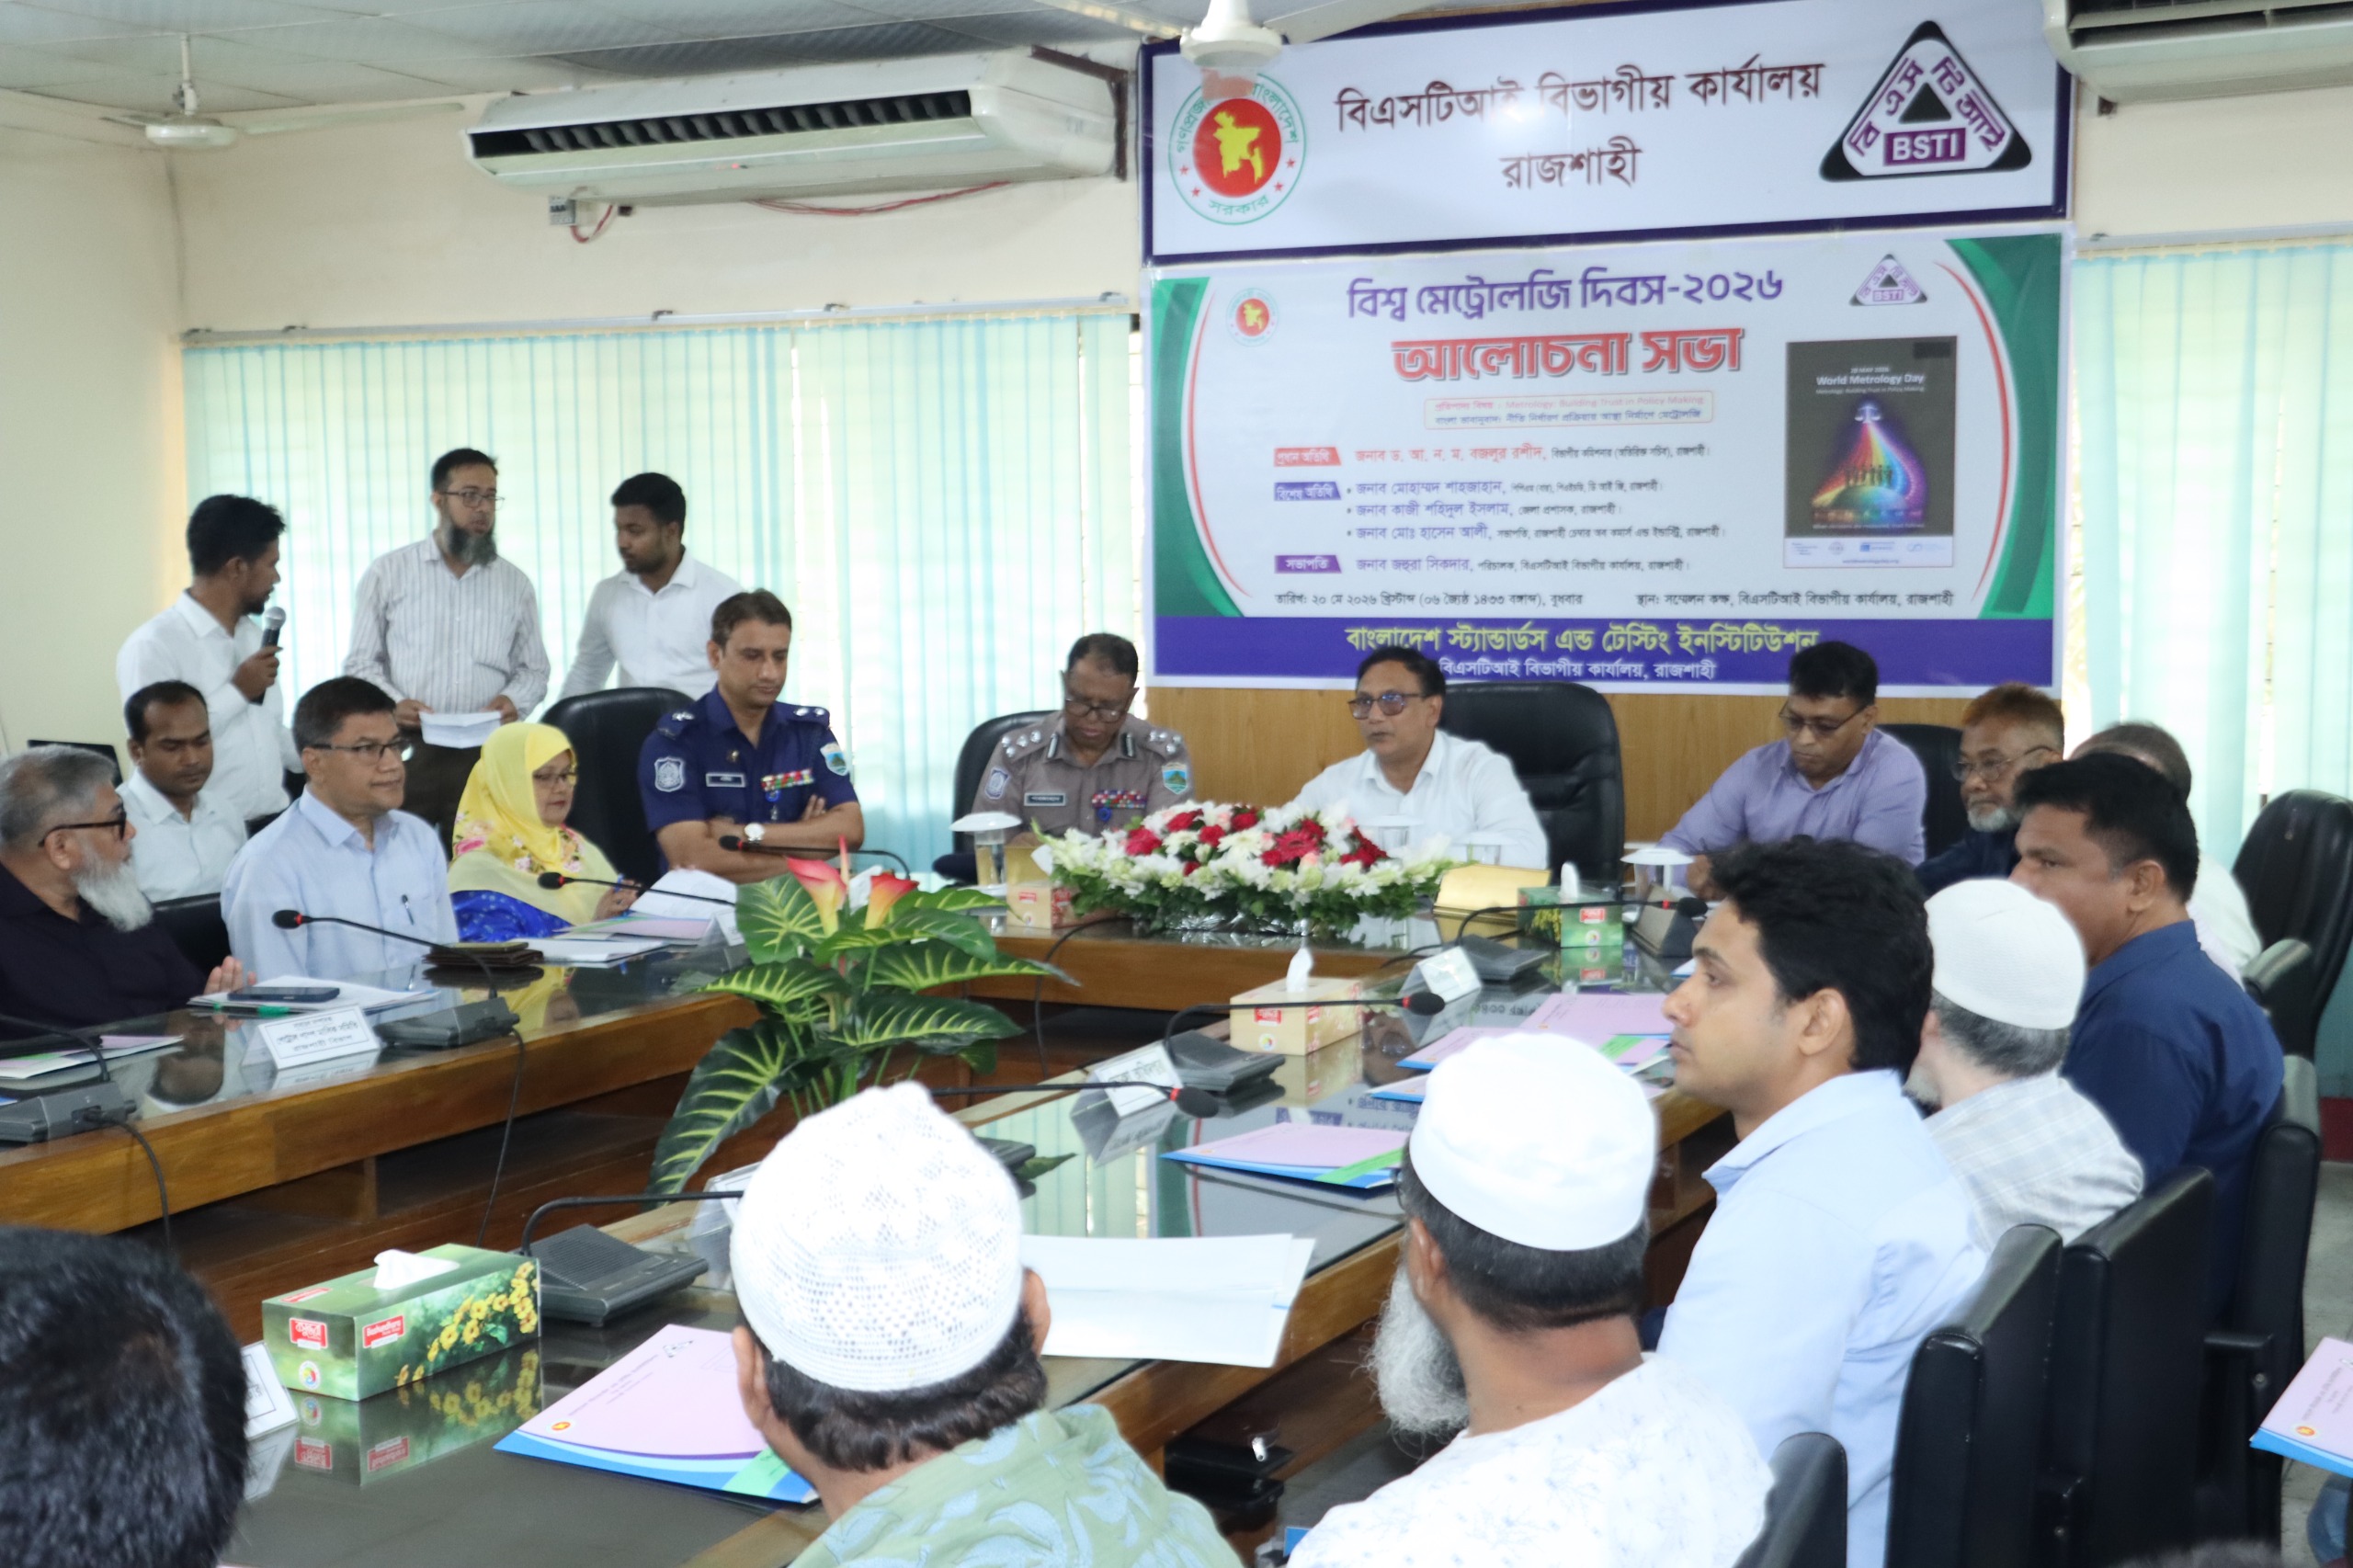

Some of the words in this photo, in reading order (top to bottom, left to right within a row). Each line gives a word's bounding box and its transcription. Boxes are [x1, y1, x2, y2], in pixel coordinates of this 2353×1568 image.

[1335, 75, 1524, 131] বিএসটিআই
[1535, 64, 1676, 119] বিভাগীয়
[1684, 53, 1825, 107] কার্যালয়
[1892, 131, 1959, 161] BSTI
[1500, 136, 1643, 189] রাজশাহী
[1347, 278, 1406, 322] বিশ্ব
[1416, 269, 1573, 320] মেট্রোলজি
[1579, 267, 1783, 308] দিবস-২০২৬
[1391, 332, 1631, 381] আলোচনা
[1639, 327, 1745, 373] সভা
[1816, 376, 1847, 386] World
[1849, 374, 1902, 386] Metrology
[1904, 374, 1925, 384] Day
[1355, 449, 1387, 462] জনাব
[1356, 483, 1387, 495] জনাব
[1356, 505, 1387, 517] জনাব
[1392, 501, 1420, 517] কাজী
[1469, 501, 1513, 517] ইসলাম,
[1356, 527, 1387, 540] জনাব
[1459, 522, 1492, 541] আলী,
[1285, 555, 1328, 571] সভাপতি
[1356, 558, 1387, 572] জনাব
[1905, 590, 1953, 607] রাজশাহী
[1345, 627, 1442, 652] বাংলাদেশ
[1554, 629, 1595, 651] এন্ড
[1601, 621, 1671, 655] টেস্টিং
[1438, 657, 1520, 678] বিএসটিআই
[1524, 656, 1584, 677] বিভাগীয়
[1654, 659, 1717, 680] রাজশাহী
